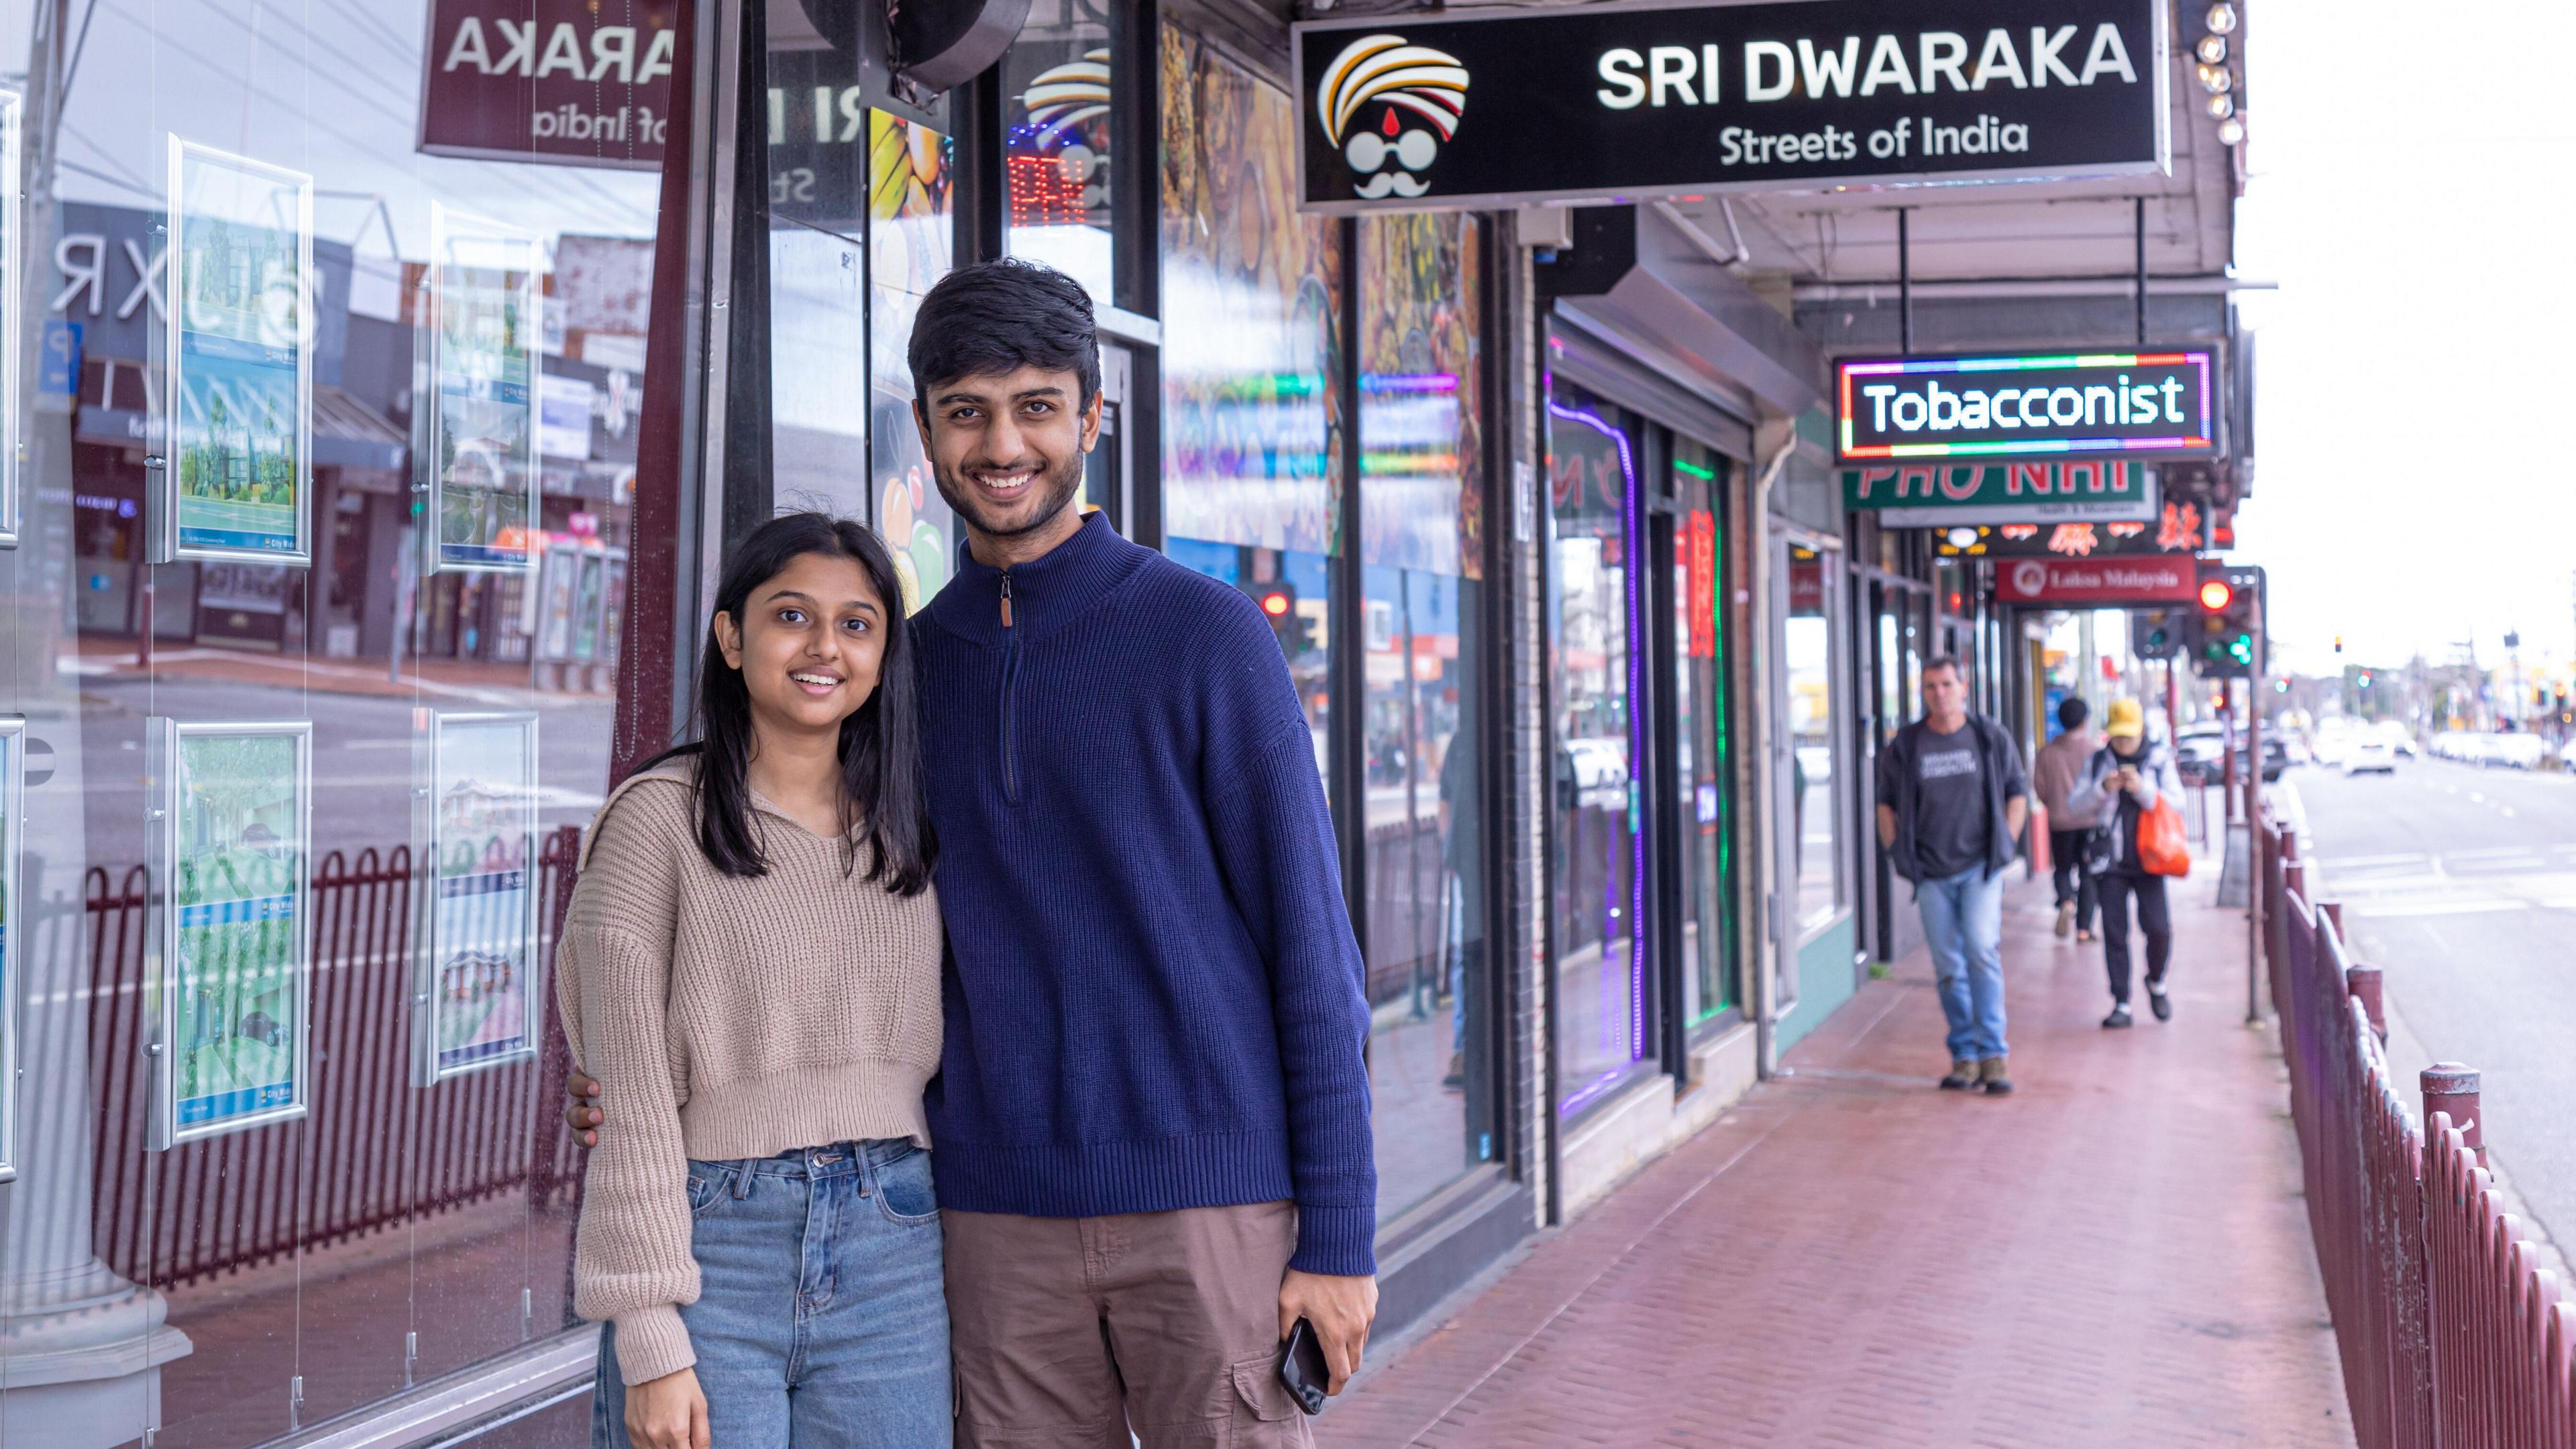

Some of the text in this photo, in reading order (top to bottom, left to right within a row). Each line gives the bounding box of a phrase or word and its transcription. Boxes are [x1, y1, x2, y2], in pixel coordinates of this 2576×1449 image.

[1596, 22, 2138, 109] SRI DWARAKA
[1720, 114, 2029, 166] Streets of India
[1863, 374, 2184, 432] Tobacconist
